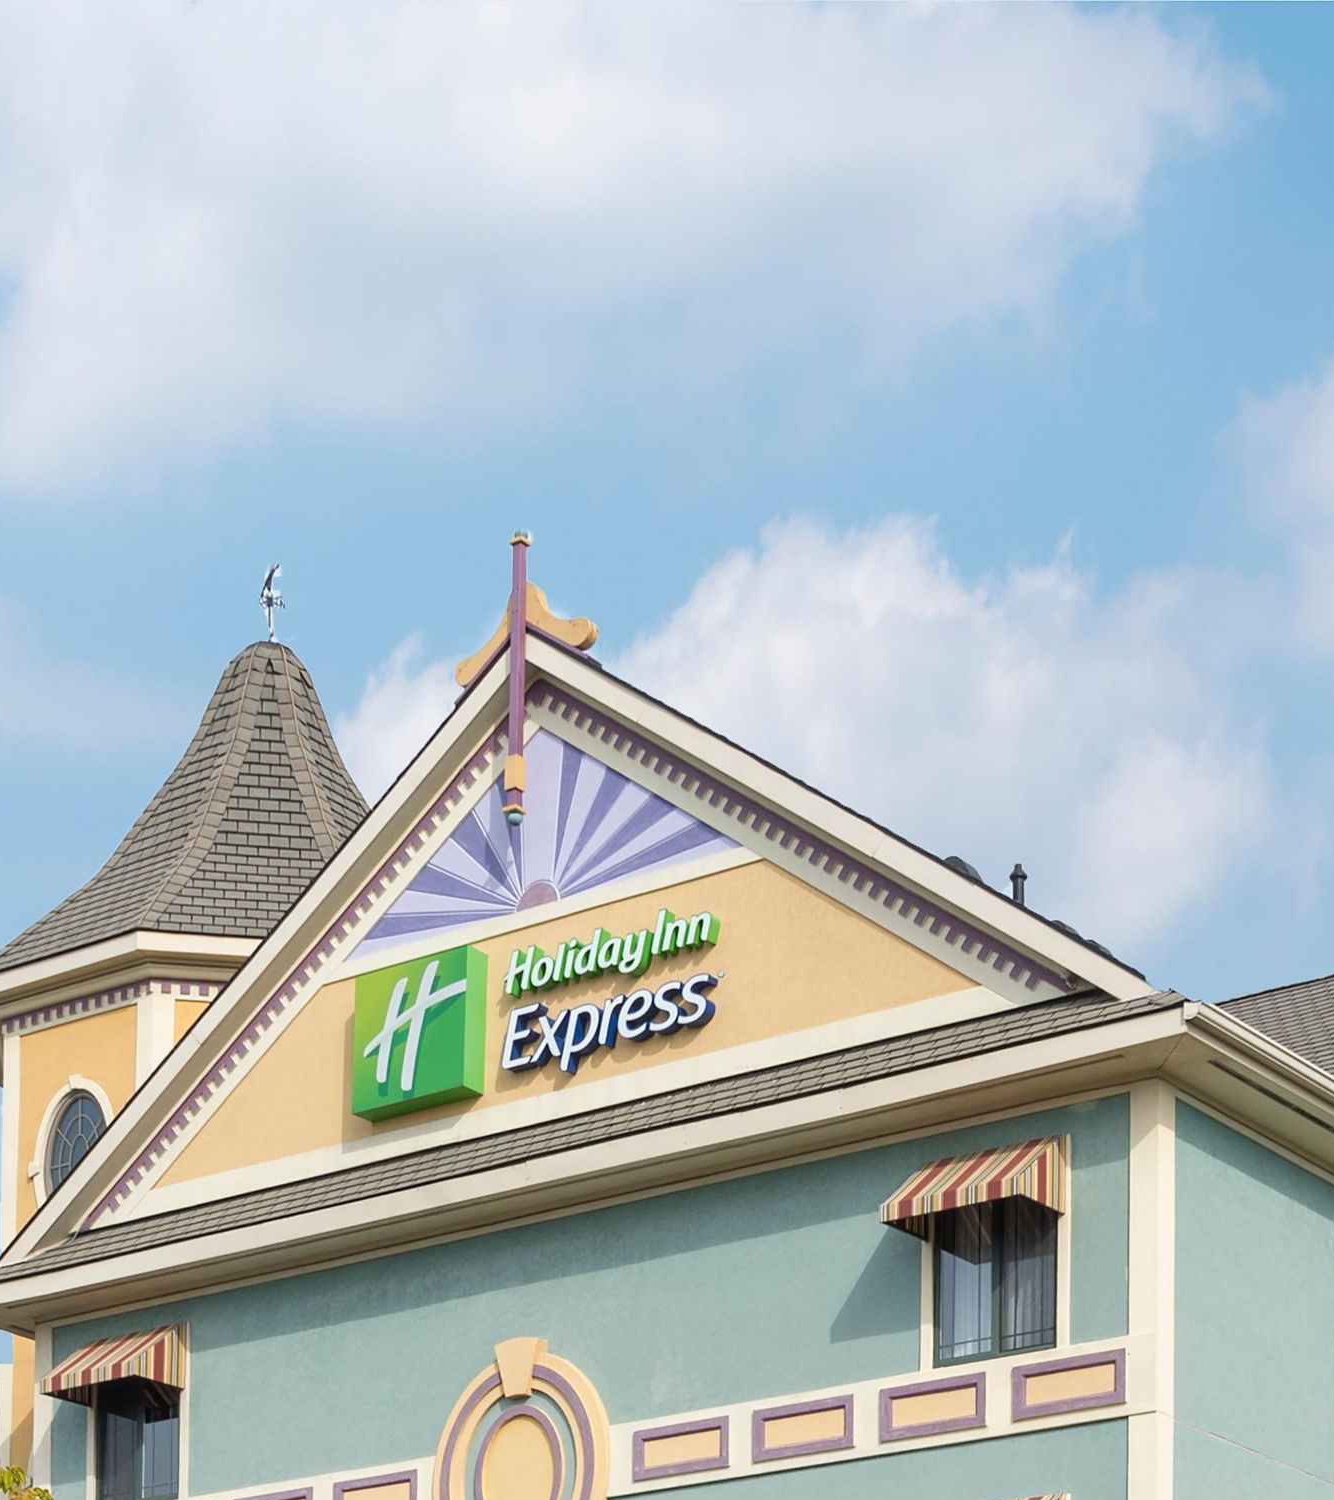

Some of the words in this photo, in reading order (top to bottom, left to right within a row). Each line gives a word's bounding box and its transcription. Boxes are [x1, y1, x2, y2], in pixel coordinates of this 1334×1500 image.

[503, 927, 652, 998] Holiday
[651, 907, 720, 960] Inn
[501, 973, 718, 1075] Express
